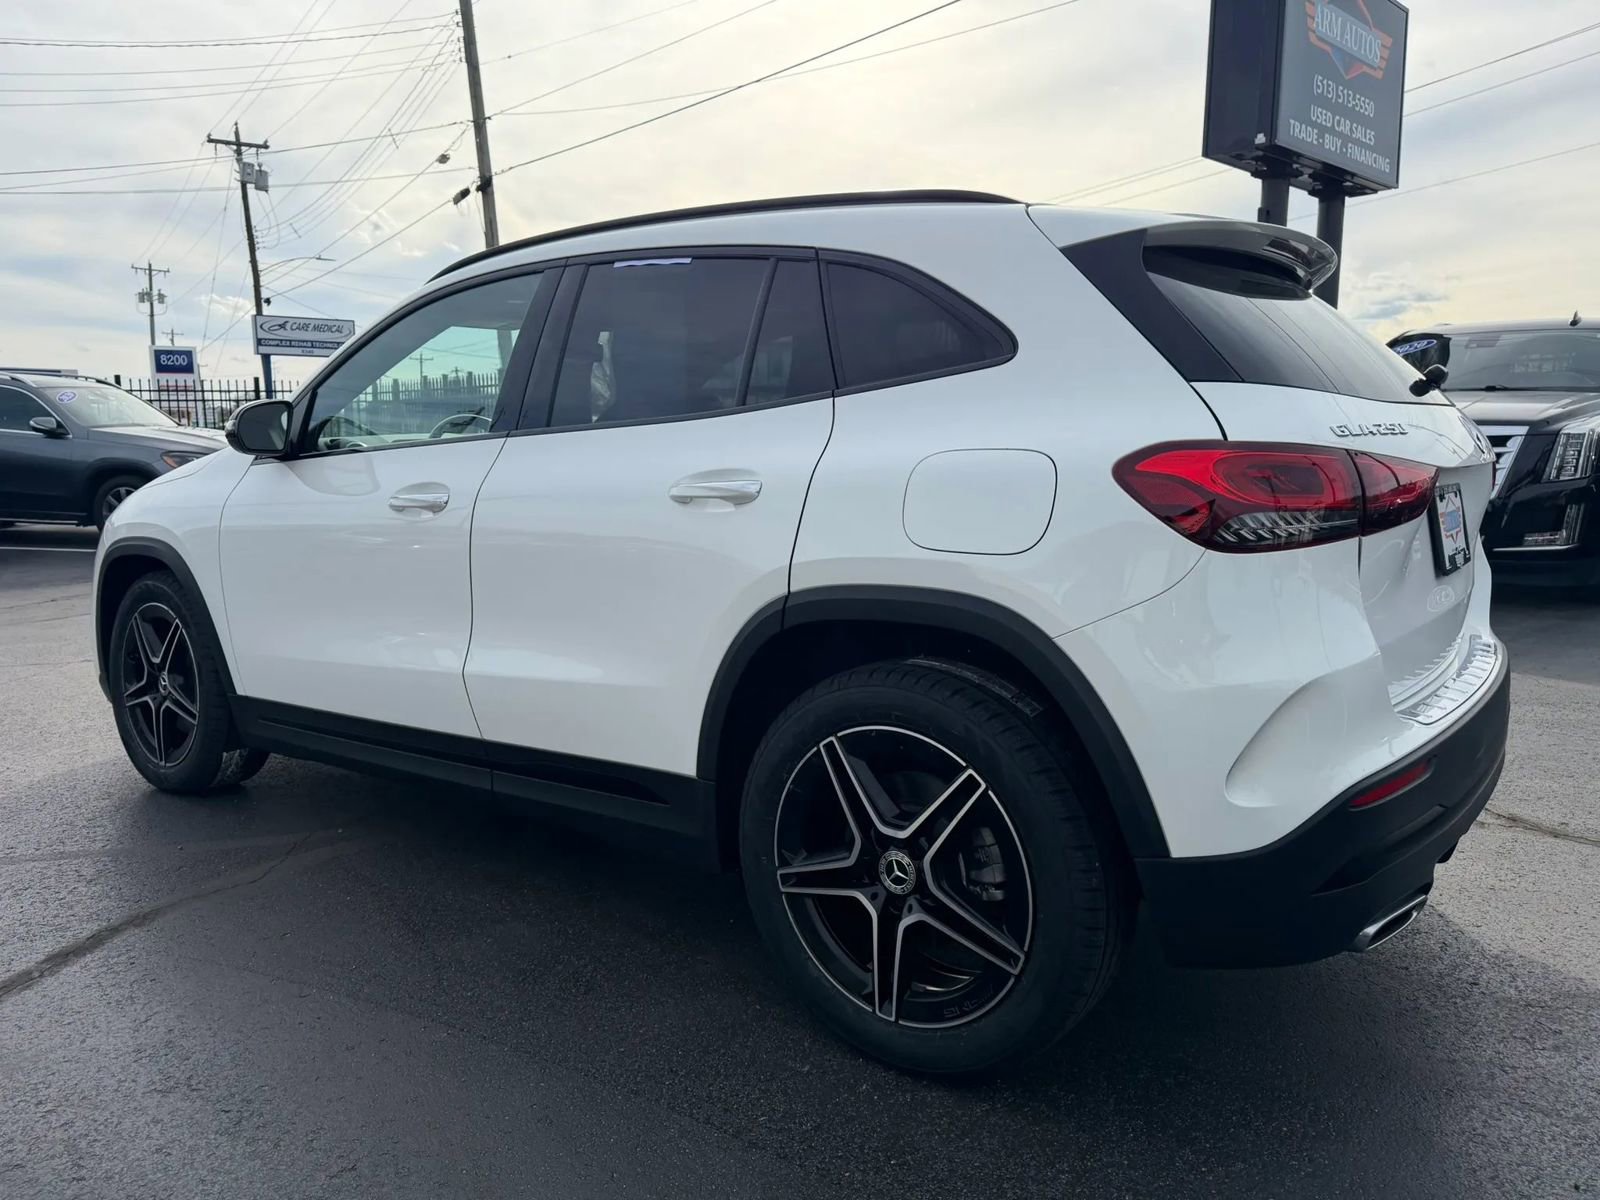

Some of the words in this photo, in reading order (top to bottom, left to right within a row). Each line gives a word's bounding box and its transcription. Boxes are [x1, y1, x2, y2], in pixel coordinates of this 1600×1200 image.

[1313, 3, 1342, 41] ARM
[1342, 22, 1381, 63] AUTOS
[1313, 74, 1336, 103] (513)
[1337, 87, 1375, 118] 513-5550
[1289, 119, 1318, 144] TRADE
[1324, 133, 1342, 153] BUY
[1347, 143, 1390, 173] FINANCING
[1310, 104, 1333, 127] USED
[1334, 115, 1351, 136] CAR
[1352, 123, 1375, 146] SALES
[290, 321, 310, 332] CARE
[311, 323, 344, 334] MEDICAL
[160, 354, 188, 366] 8200
